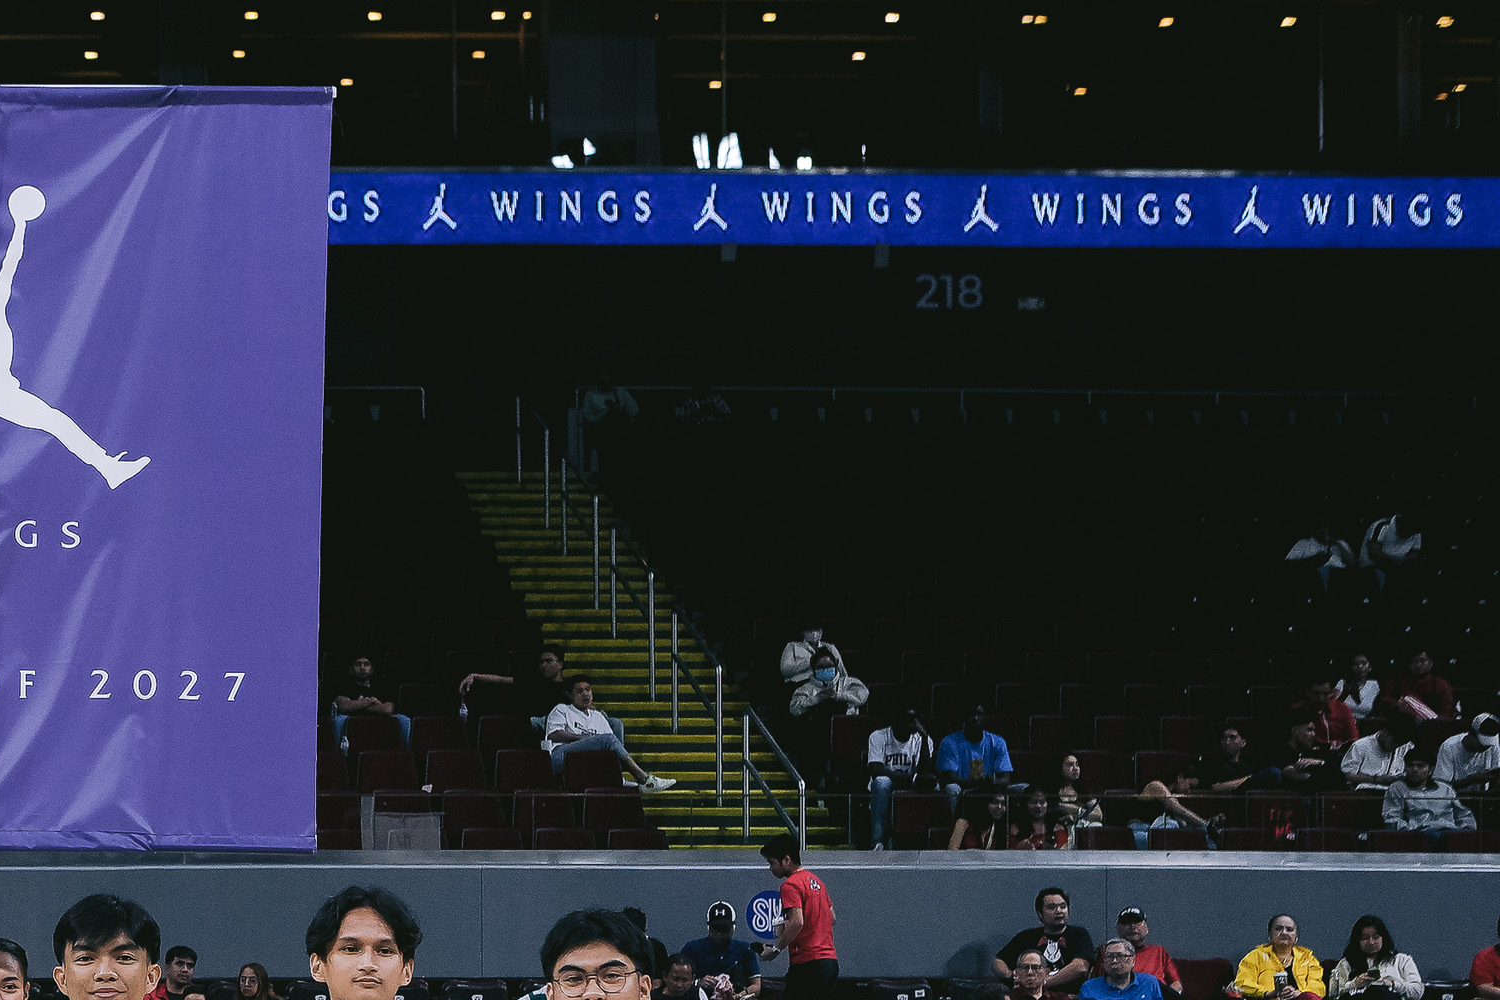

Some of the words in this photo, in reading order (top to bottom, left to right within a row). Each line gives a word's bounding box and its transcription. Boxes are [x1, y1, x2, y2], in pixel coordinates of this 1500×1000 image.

[490, 190, 652, 224] WINGS
[761, 190, 922, 225] WINGS
[1031, 192, 1192, 227] WINGS
[1301, 193, 1463, 227] WINGS
[916, 274, 984, 310] 218
[88, 669, 247, 702] 2027
